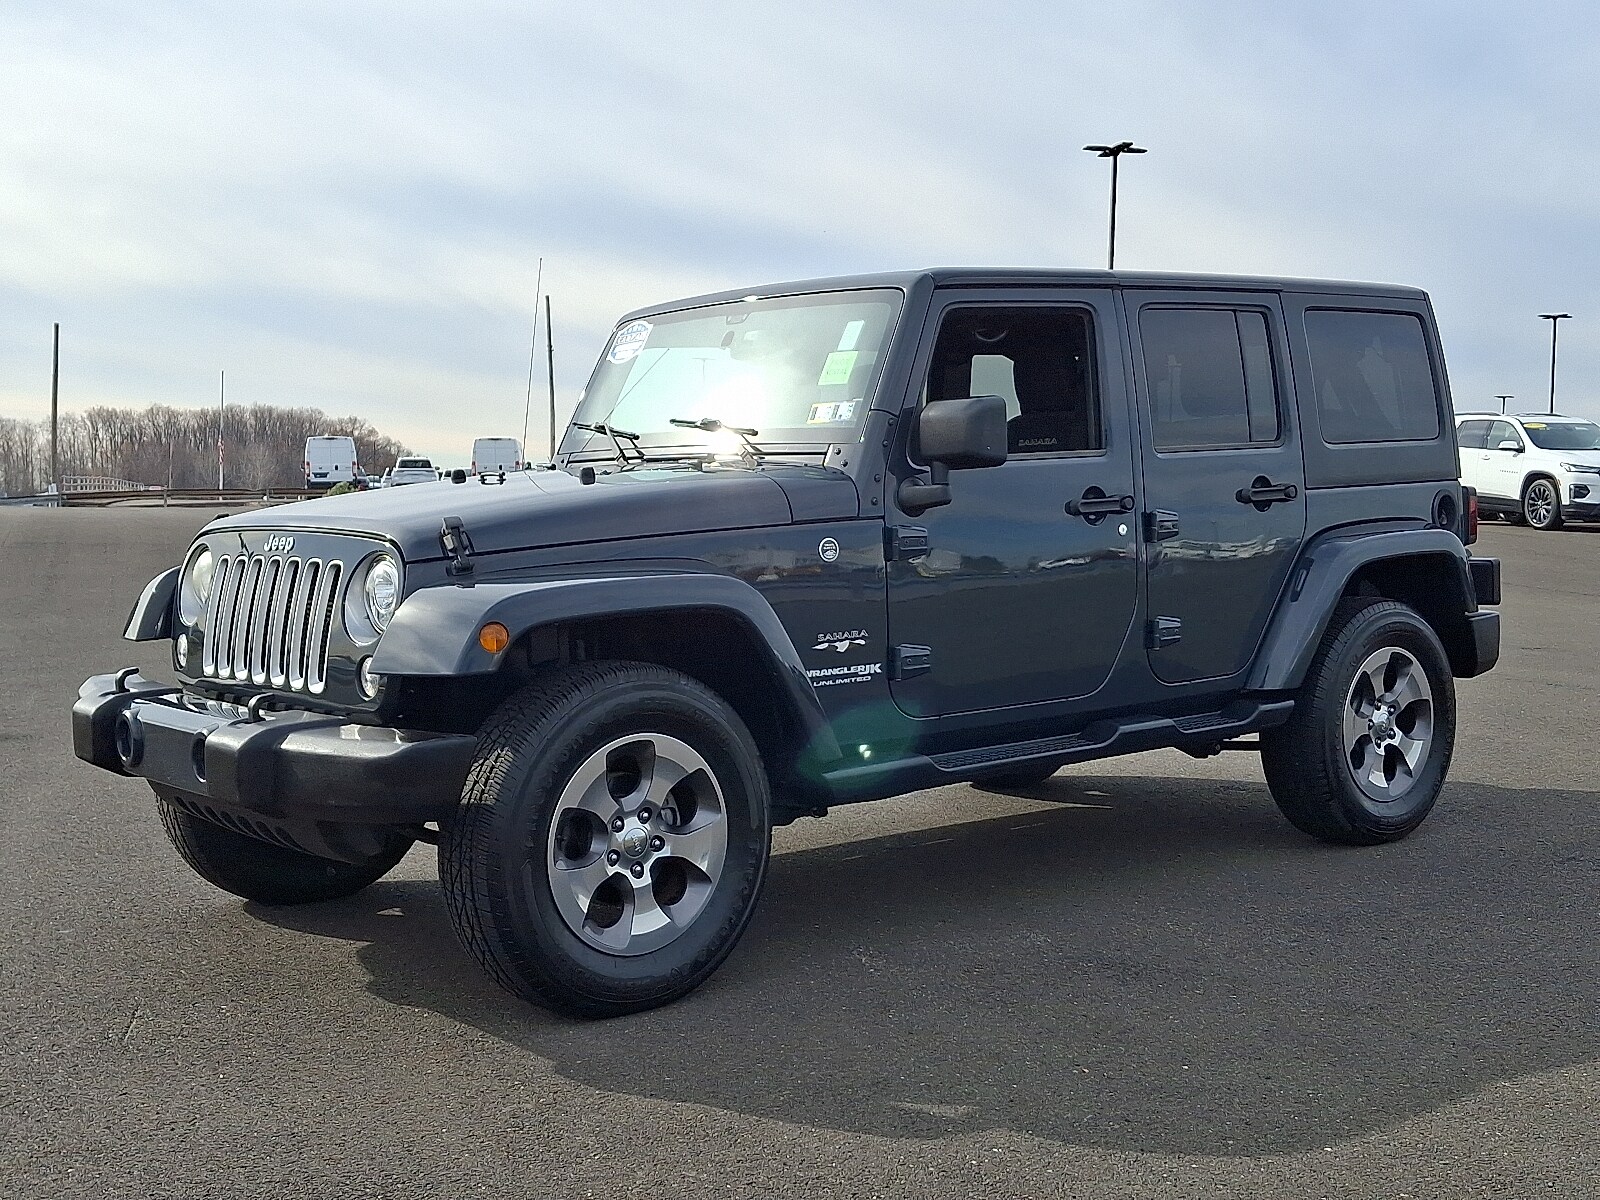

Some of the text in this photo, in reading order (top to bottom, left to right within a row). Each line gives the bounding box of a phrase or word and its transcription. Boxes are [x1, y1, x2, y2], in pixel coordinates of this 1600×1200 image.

[263, 533, 295, 554] Jeep
[817, 629, 869, 642] SAHARA
[813, 675, 872, 687] UNLIMITED
